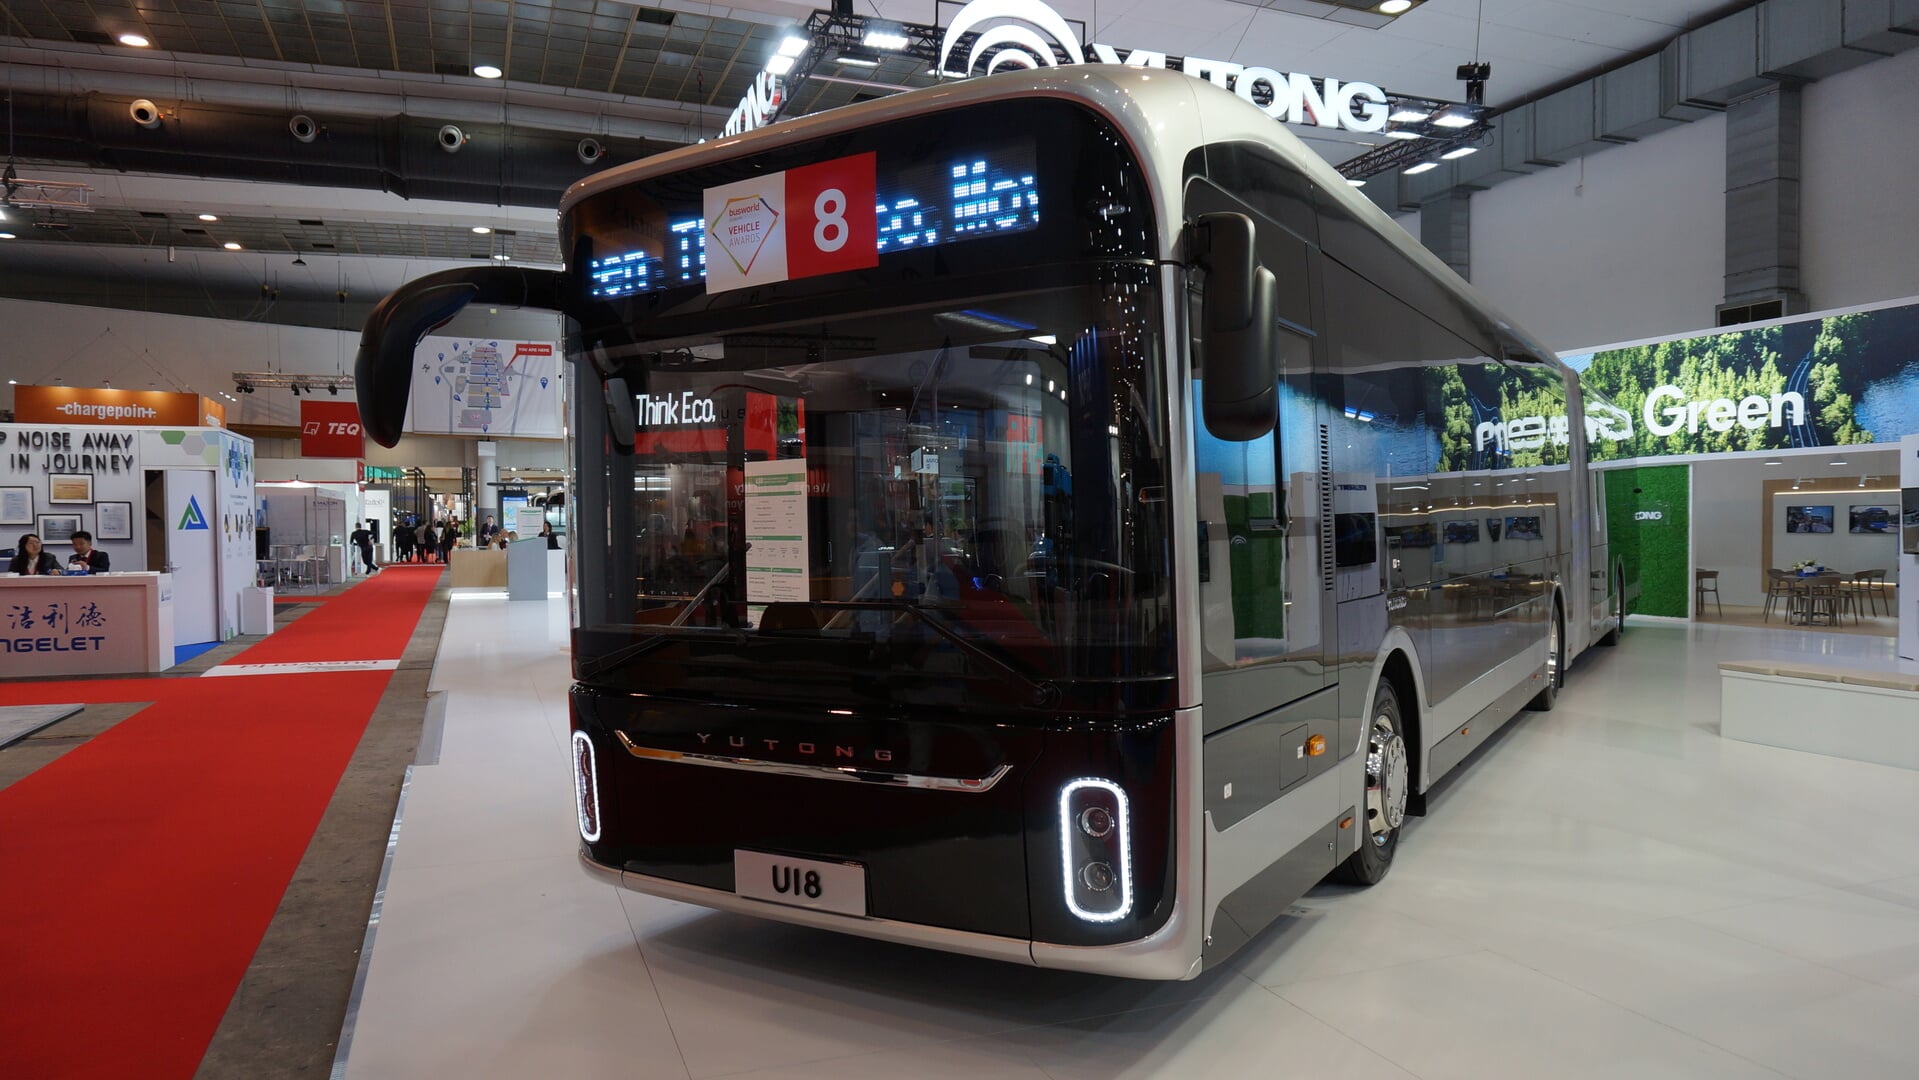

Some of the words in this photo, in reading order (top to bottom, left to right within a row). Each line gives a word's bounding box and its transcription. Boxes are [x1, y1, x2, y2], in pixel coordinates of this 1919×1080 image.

[728, 202, 760, 217] busworld
[728, 220, 761, 236] VEHICLE
[813, 188, 849, 253] 8
[728, 232, 761, 248] AWARDS
[636, 392, 679, 426] Think
[681, 391, 717, 424] Eco,
[1643, 384, 1805, 437] Green
[327, 422, 360, 435] TEQ
[18, 431, 72, 448] NOISE
[82, 432, 133, 450] AWAY
[10, 453, 30, 470] IN
[42, 454, 134, 471] JOURNEY
[697, 731, 893, 762] YUTONG
